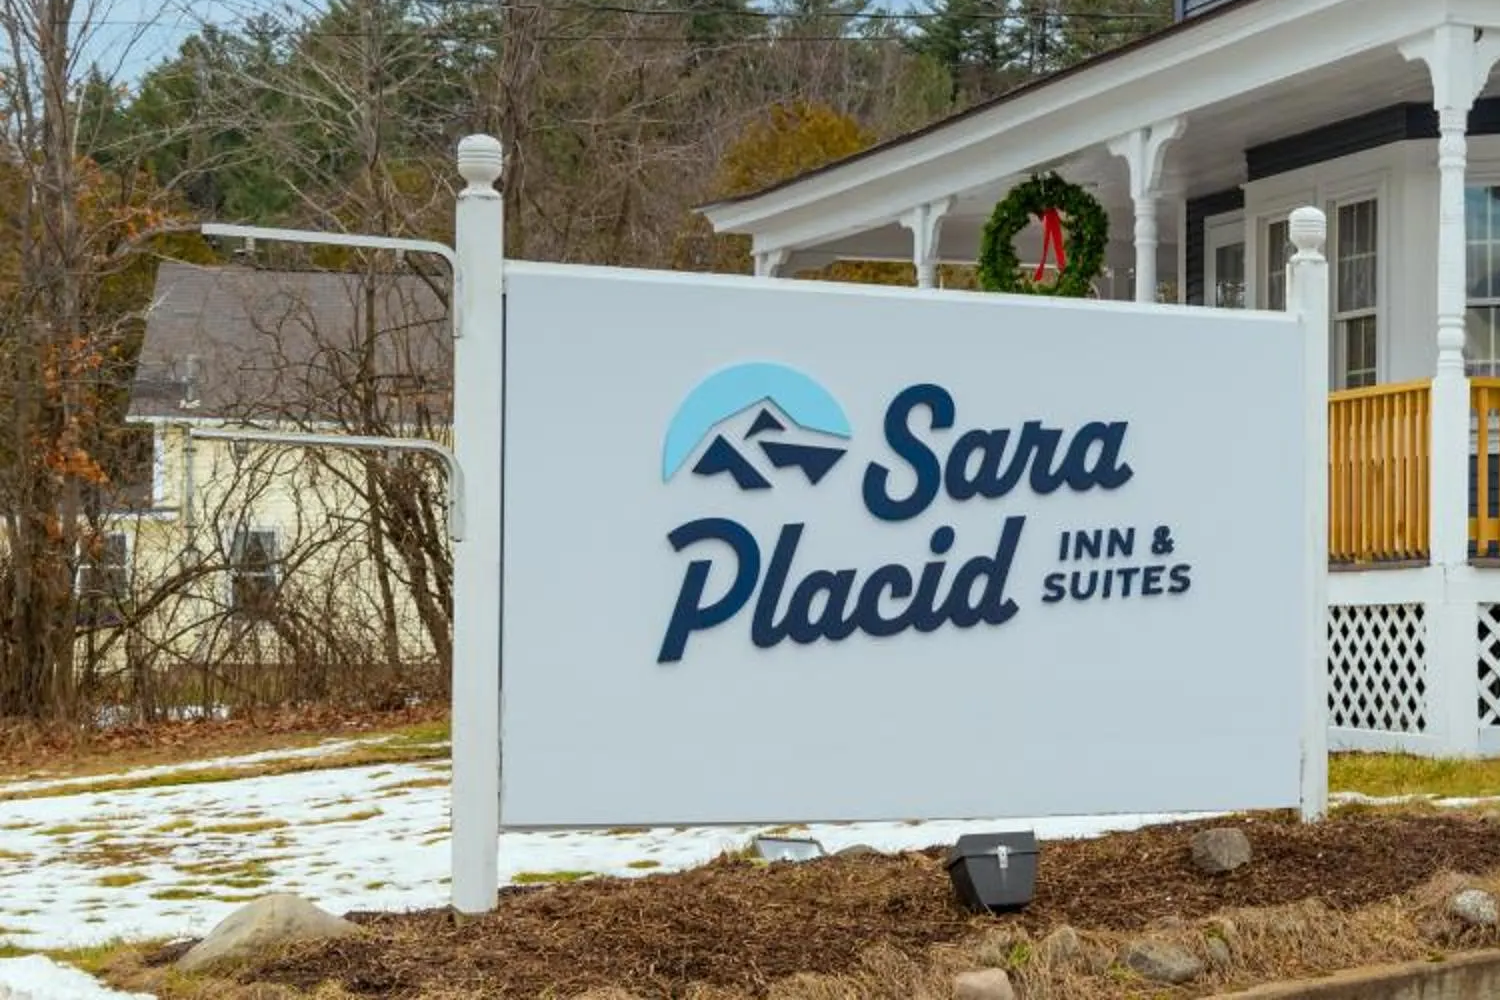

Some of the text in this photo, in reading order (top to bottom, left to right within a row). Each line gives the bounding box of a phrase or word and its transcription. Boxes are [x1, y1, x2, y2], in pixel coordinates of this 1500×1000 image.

[861, 383, 1134, 523] Sara
[1041, 563, 1192, 605] SUITES
[1058, 525, 1175, 562] INN &
[656, 515, 1027, 665] Placid
